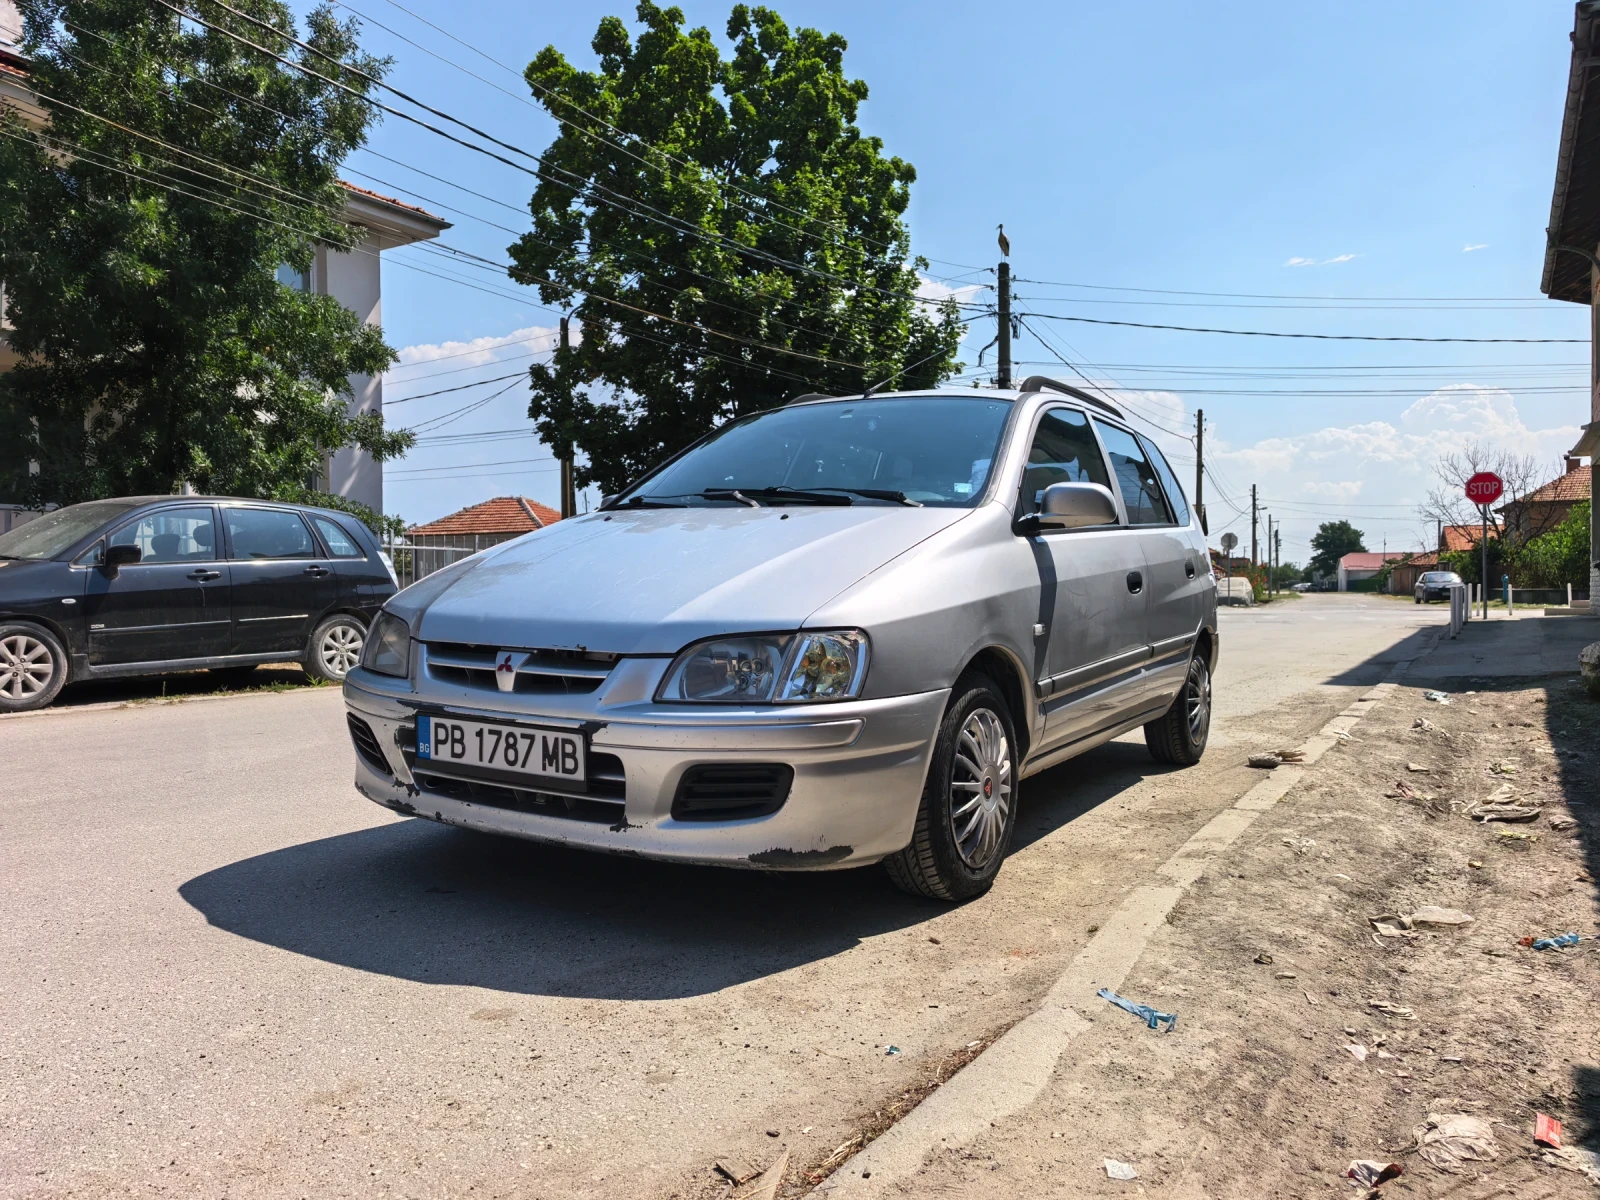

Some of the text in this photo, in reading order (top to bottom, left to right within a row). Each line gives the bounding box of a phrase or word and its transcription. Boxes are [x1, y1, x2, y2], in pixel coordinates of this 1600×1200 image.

[1469, 481, 1499, 496] STOP
[419, 742, 430, 753] BG
[434, 721, 579, 775] PB 1787 MB
